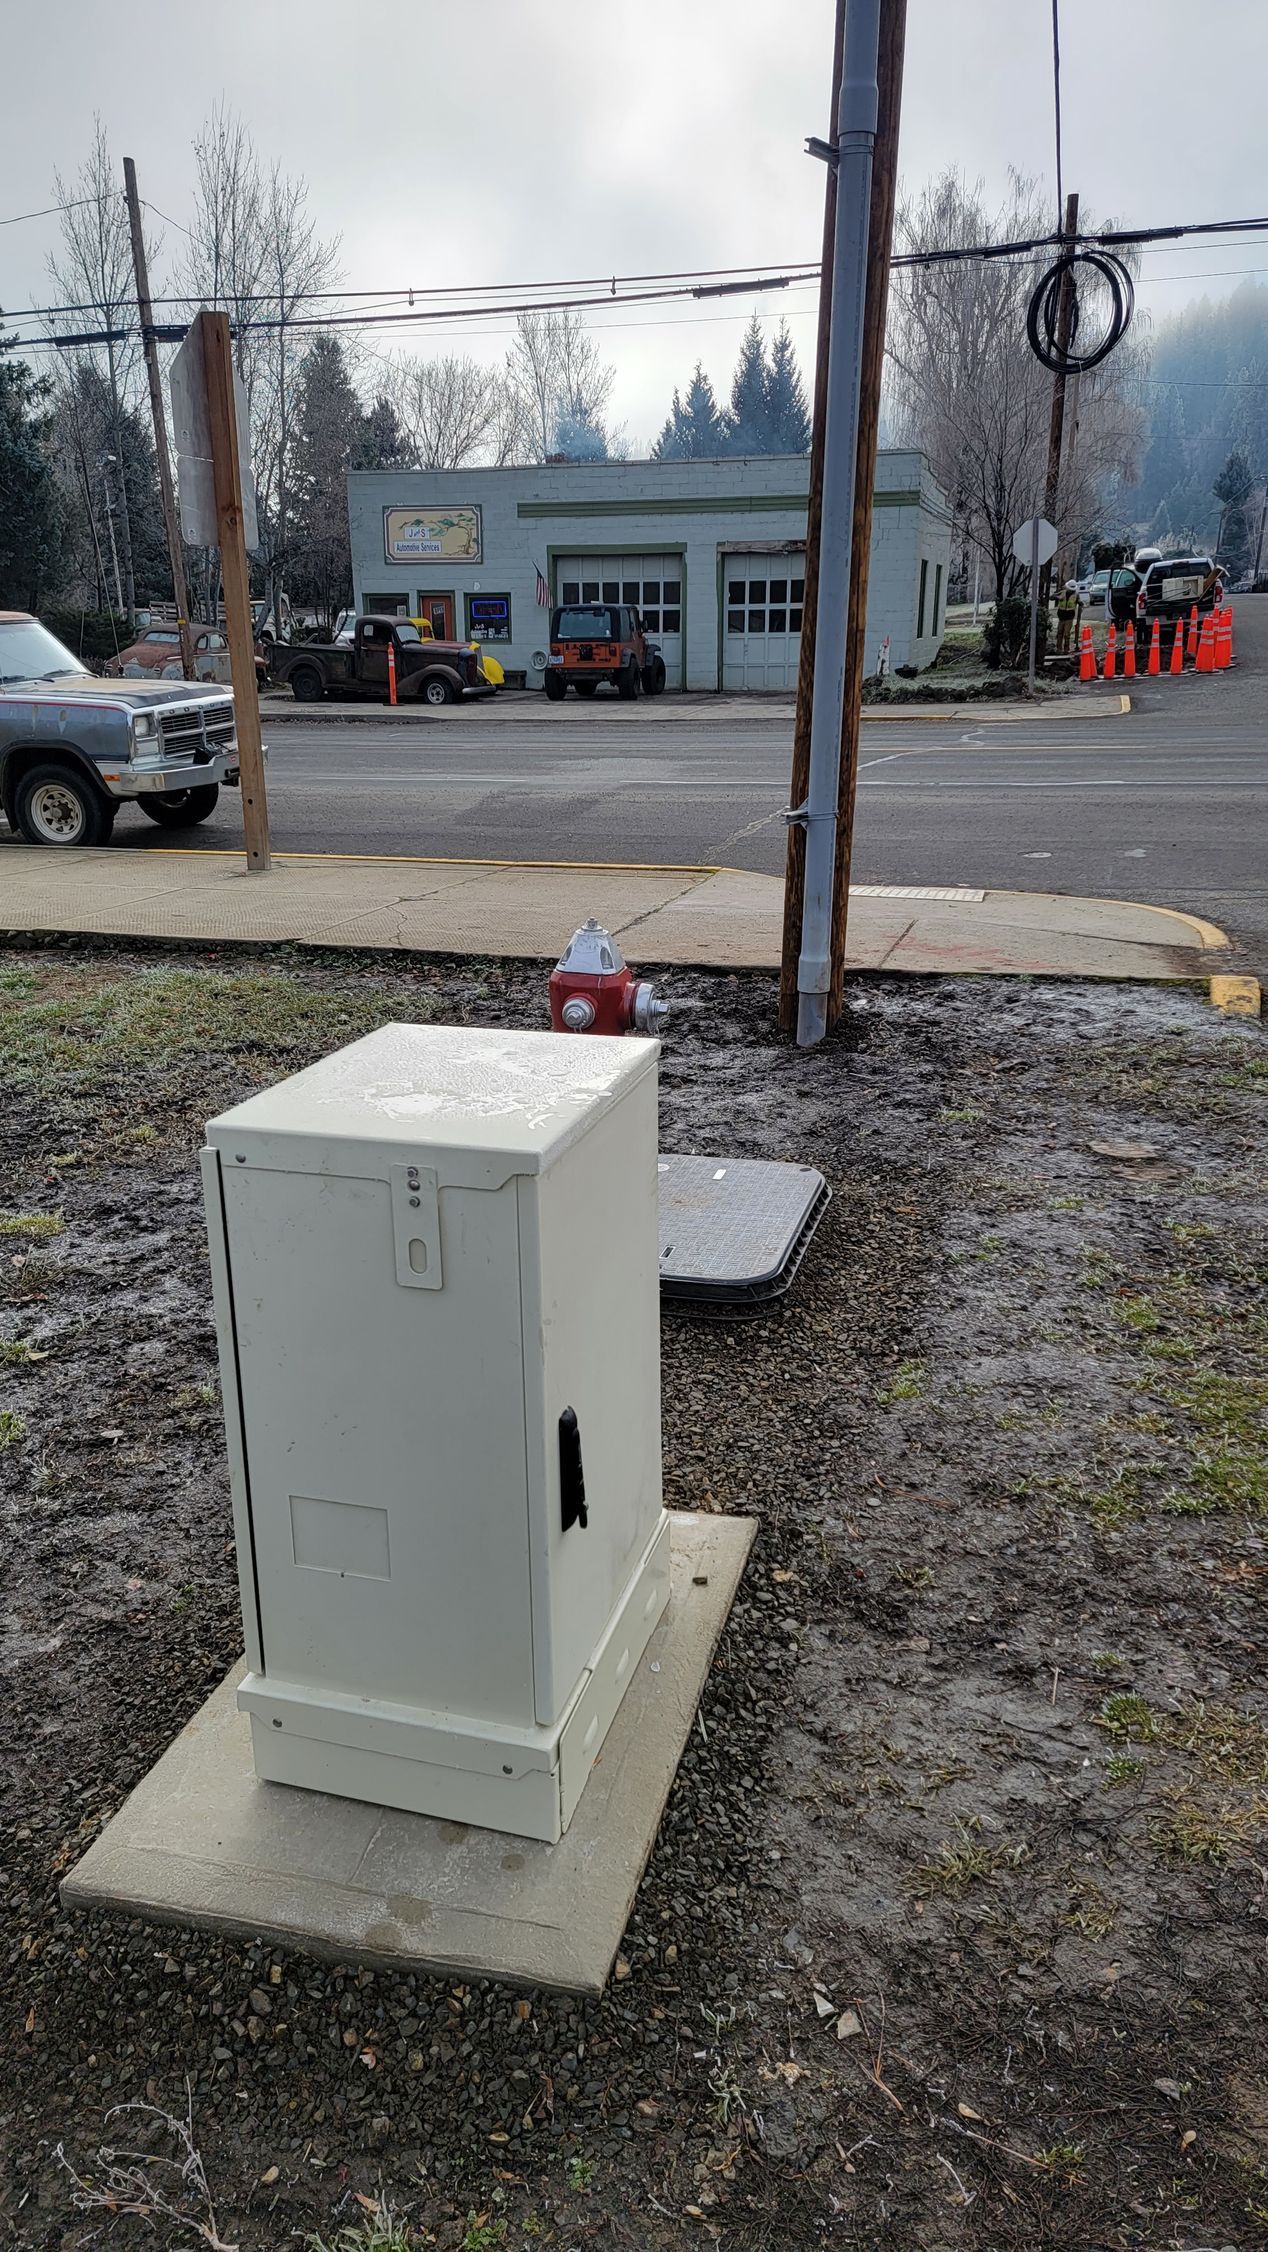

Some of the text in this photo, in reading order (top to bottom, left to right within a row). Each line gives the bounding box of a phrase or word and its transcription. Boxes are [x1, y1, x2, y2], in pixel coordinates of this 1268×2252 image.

[408, 528, 413, 538] J
[420, 528, 426, 538] S
[396, 542, 440, 552] Automotive Services
